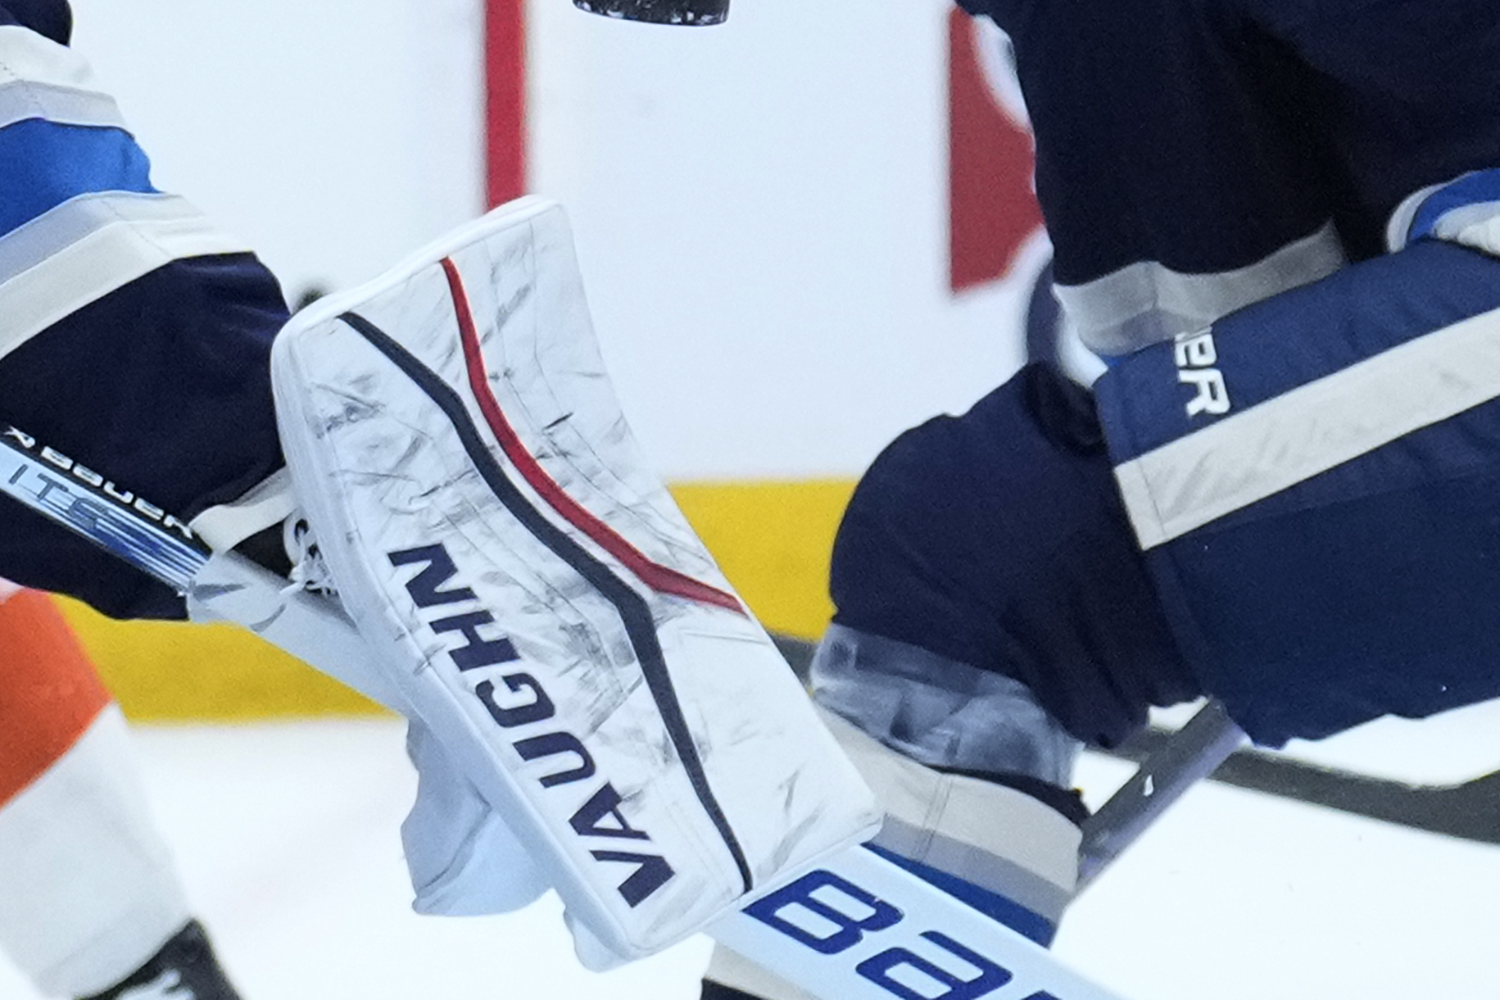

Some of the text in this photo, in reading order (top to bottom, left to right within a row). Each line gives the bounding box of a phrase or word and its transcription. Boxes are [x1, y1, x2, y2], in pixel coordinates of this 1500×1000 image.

[1174, 332, 1231, 417] ER
[386, 543, 676, 909] VAUGHN
[740, 868, 1064, 1000] BA
